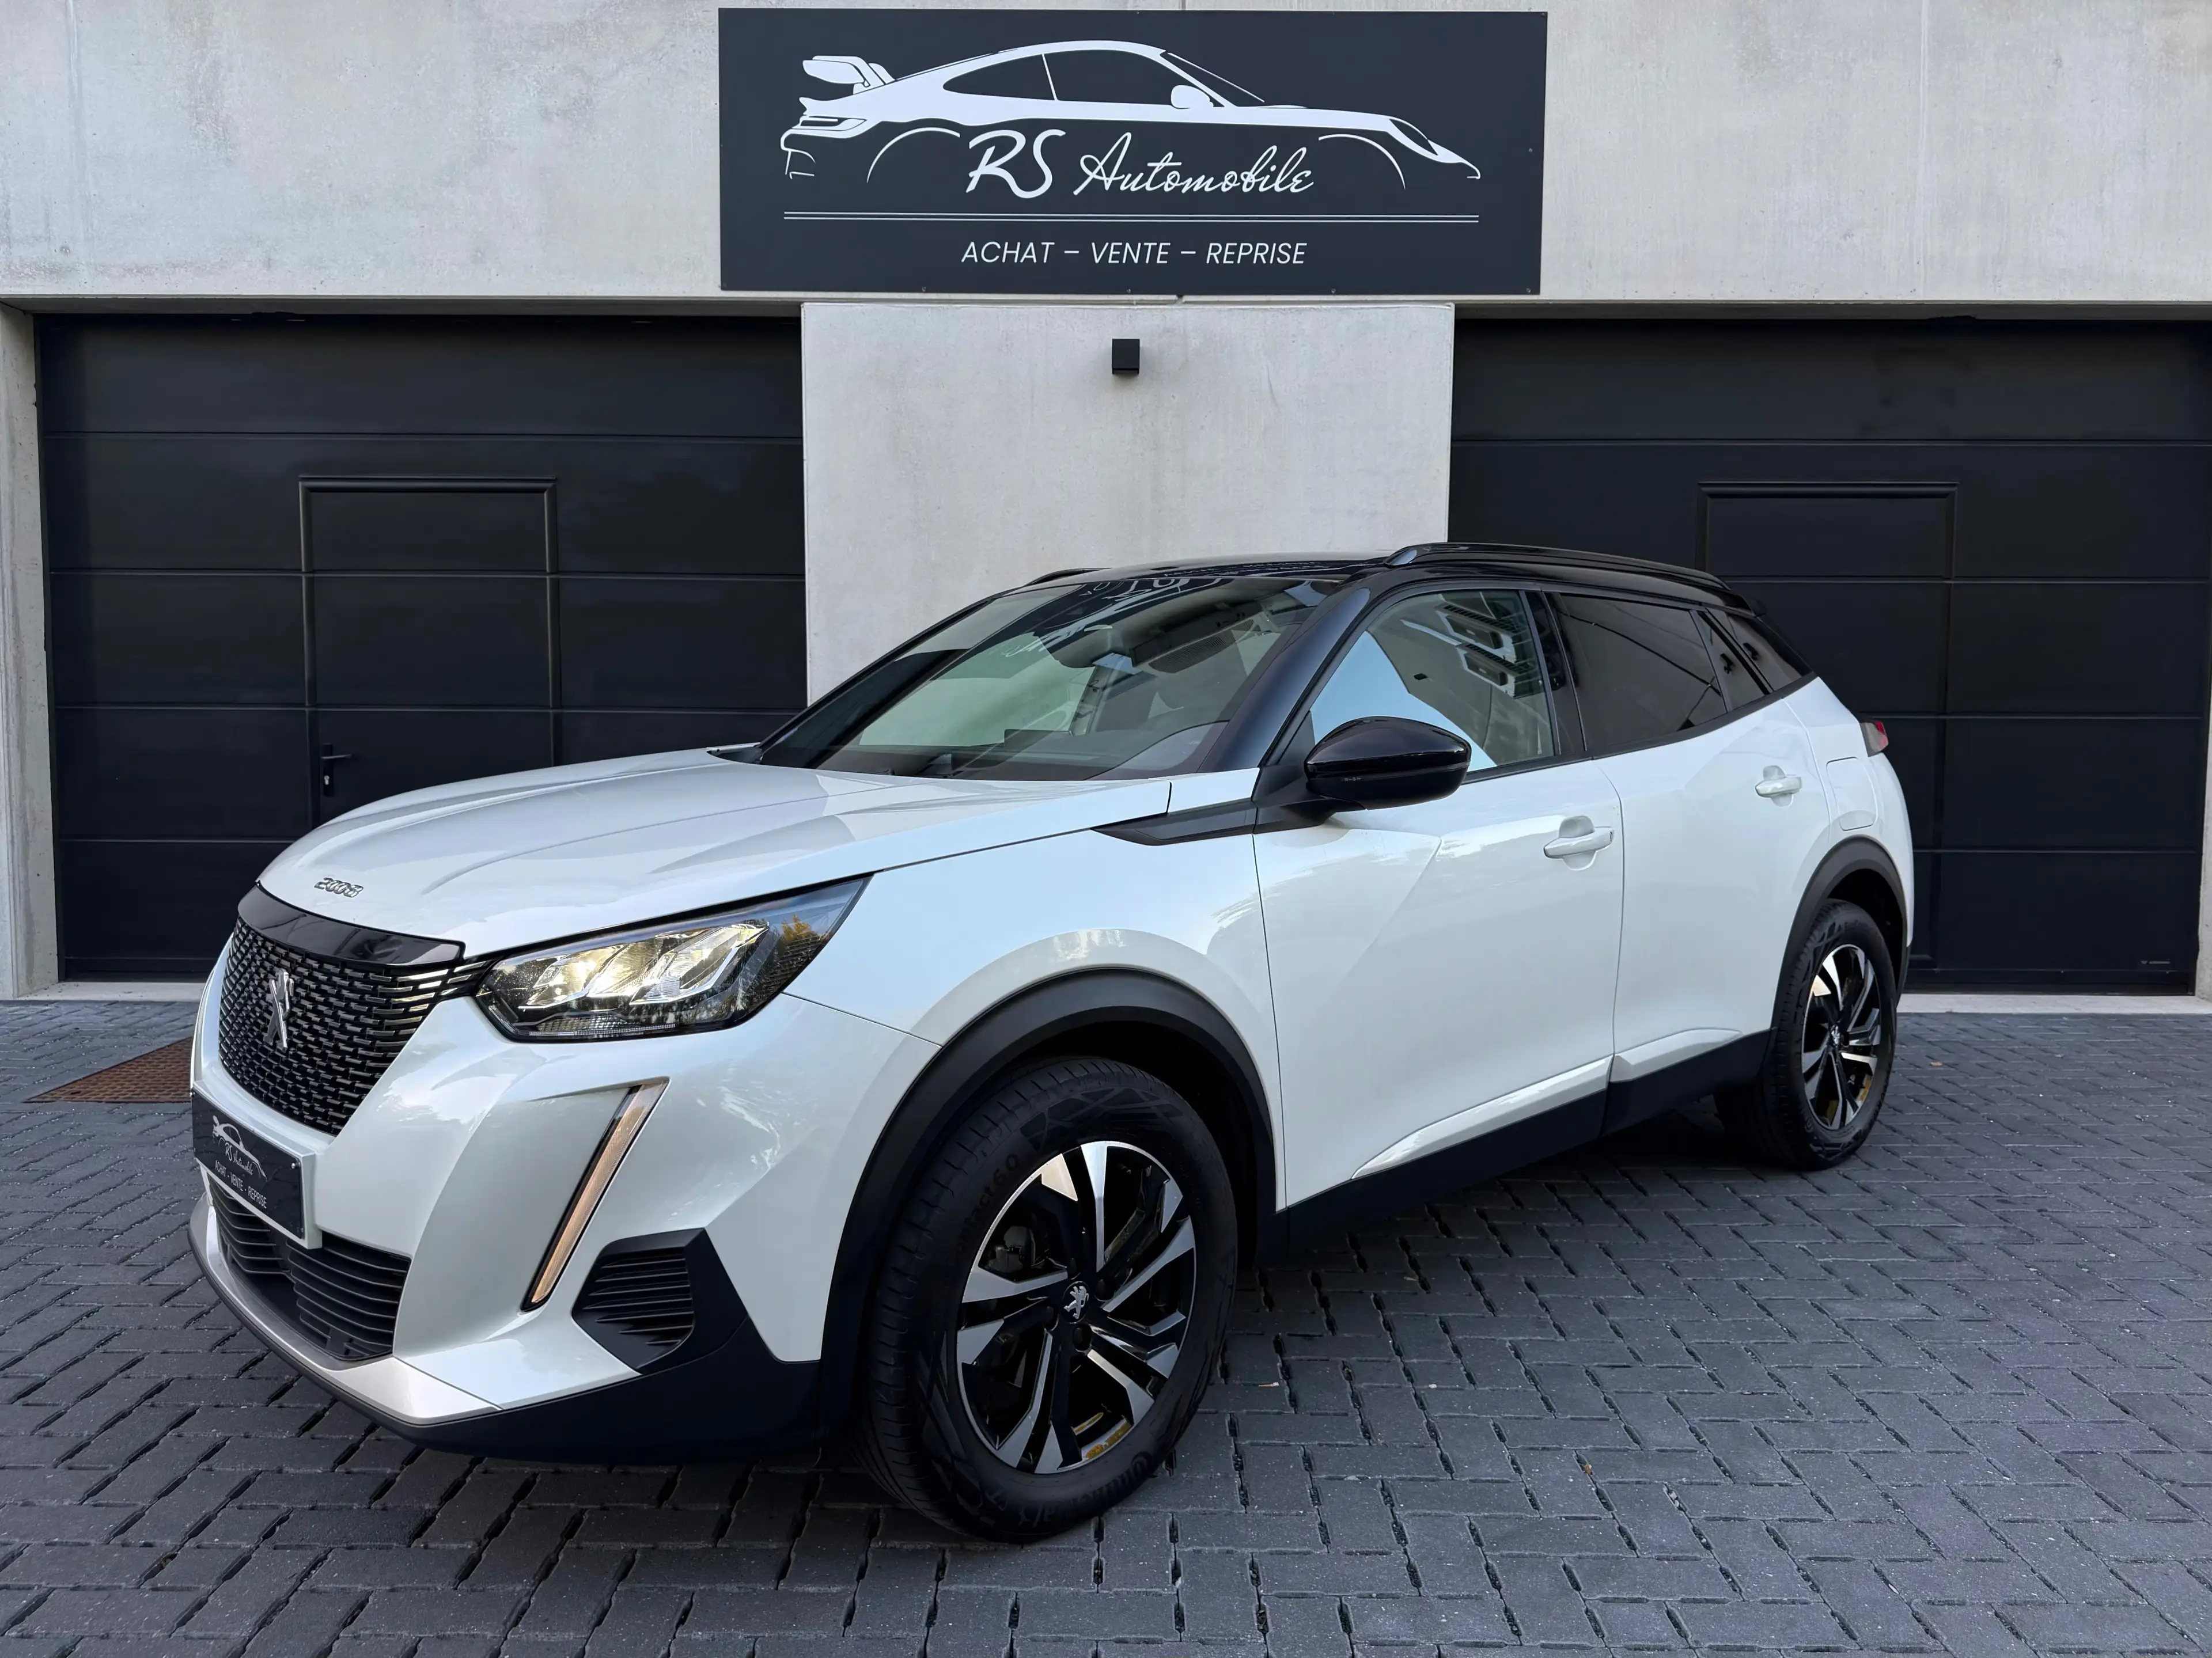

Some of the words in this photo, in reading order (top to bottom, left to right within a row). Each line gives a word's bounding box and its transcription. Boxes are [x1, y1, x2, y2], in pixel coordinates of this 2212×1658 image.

[966, 129, 1066, 198] RS
[1073, 132, 1314, 195] Automobile
[961, 242, 1055, 263] ACHAT
[1092, 242, 1171, 263] VENTE
[1206, 243, 1307, 264] REPRISE
[314, 877, 363, 898] 2008
[215, 1160, 226, 1177] ACHAT
[230, 1171, 243, 1192] VENTE
[248, 1186, 267, 1209] REPRISE
